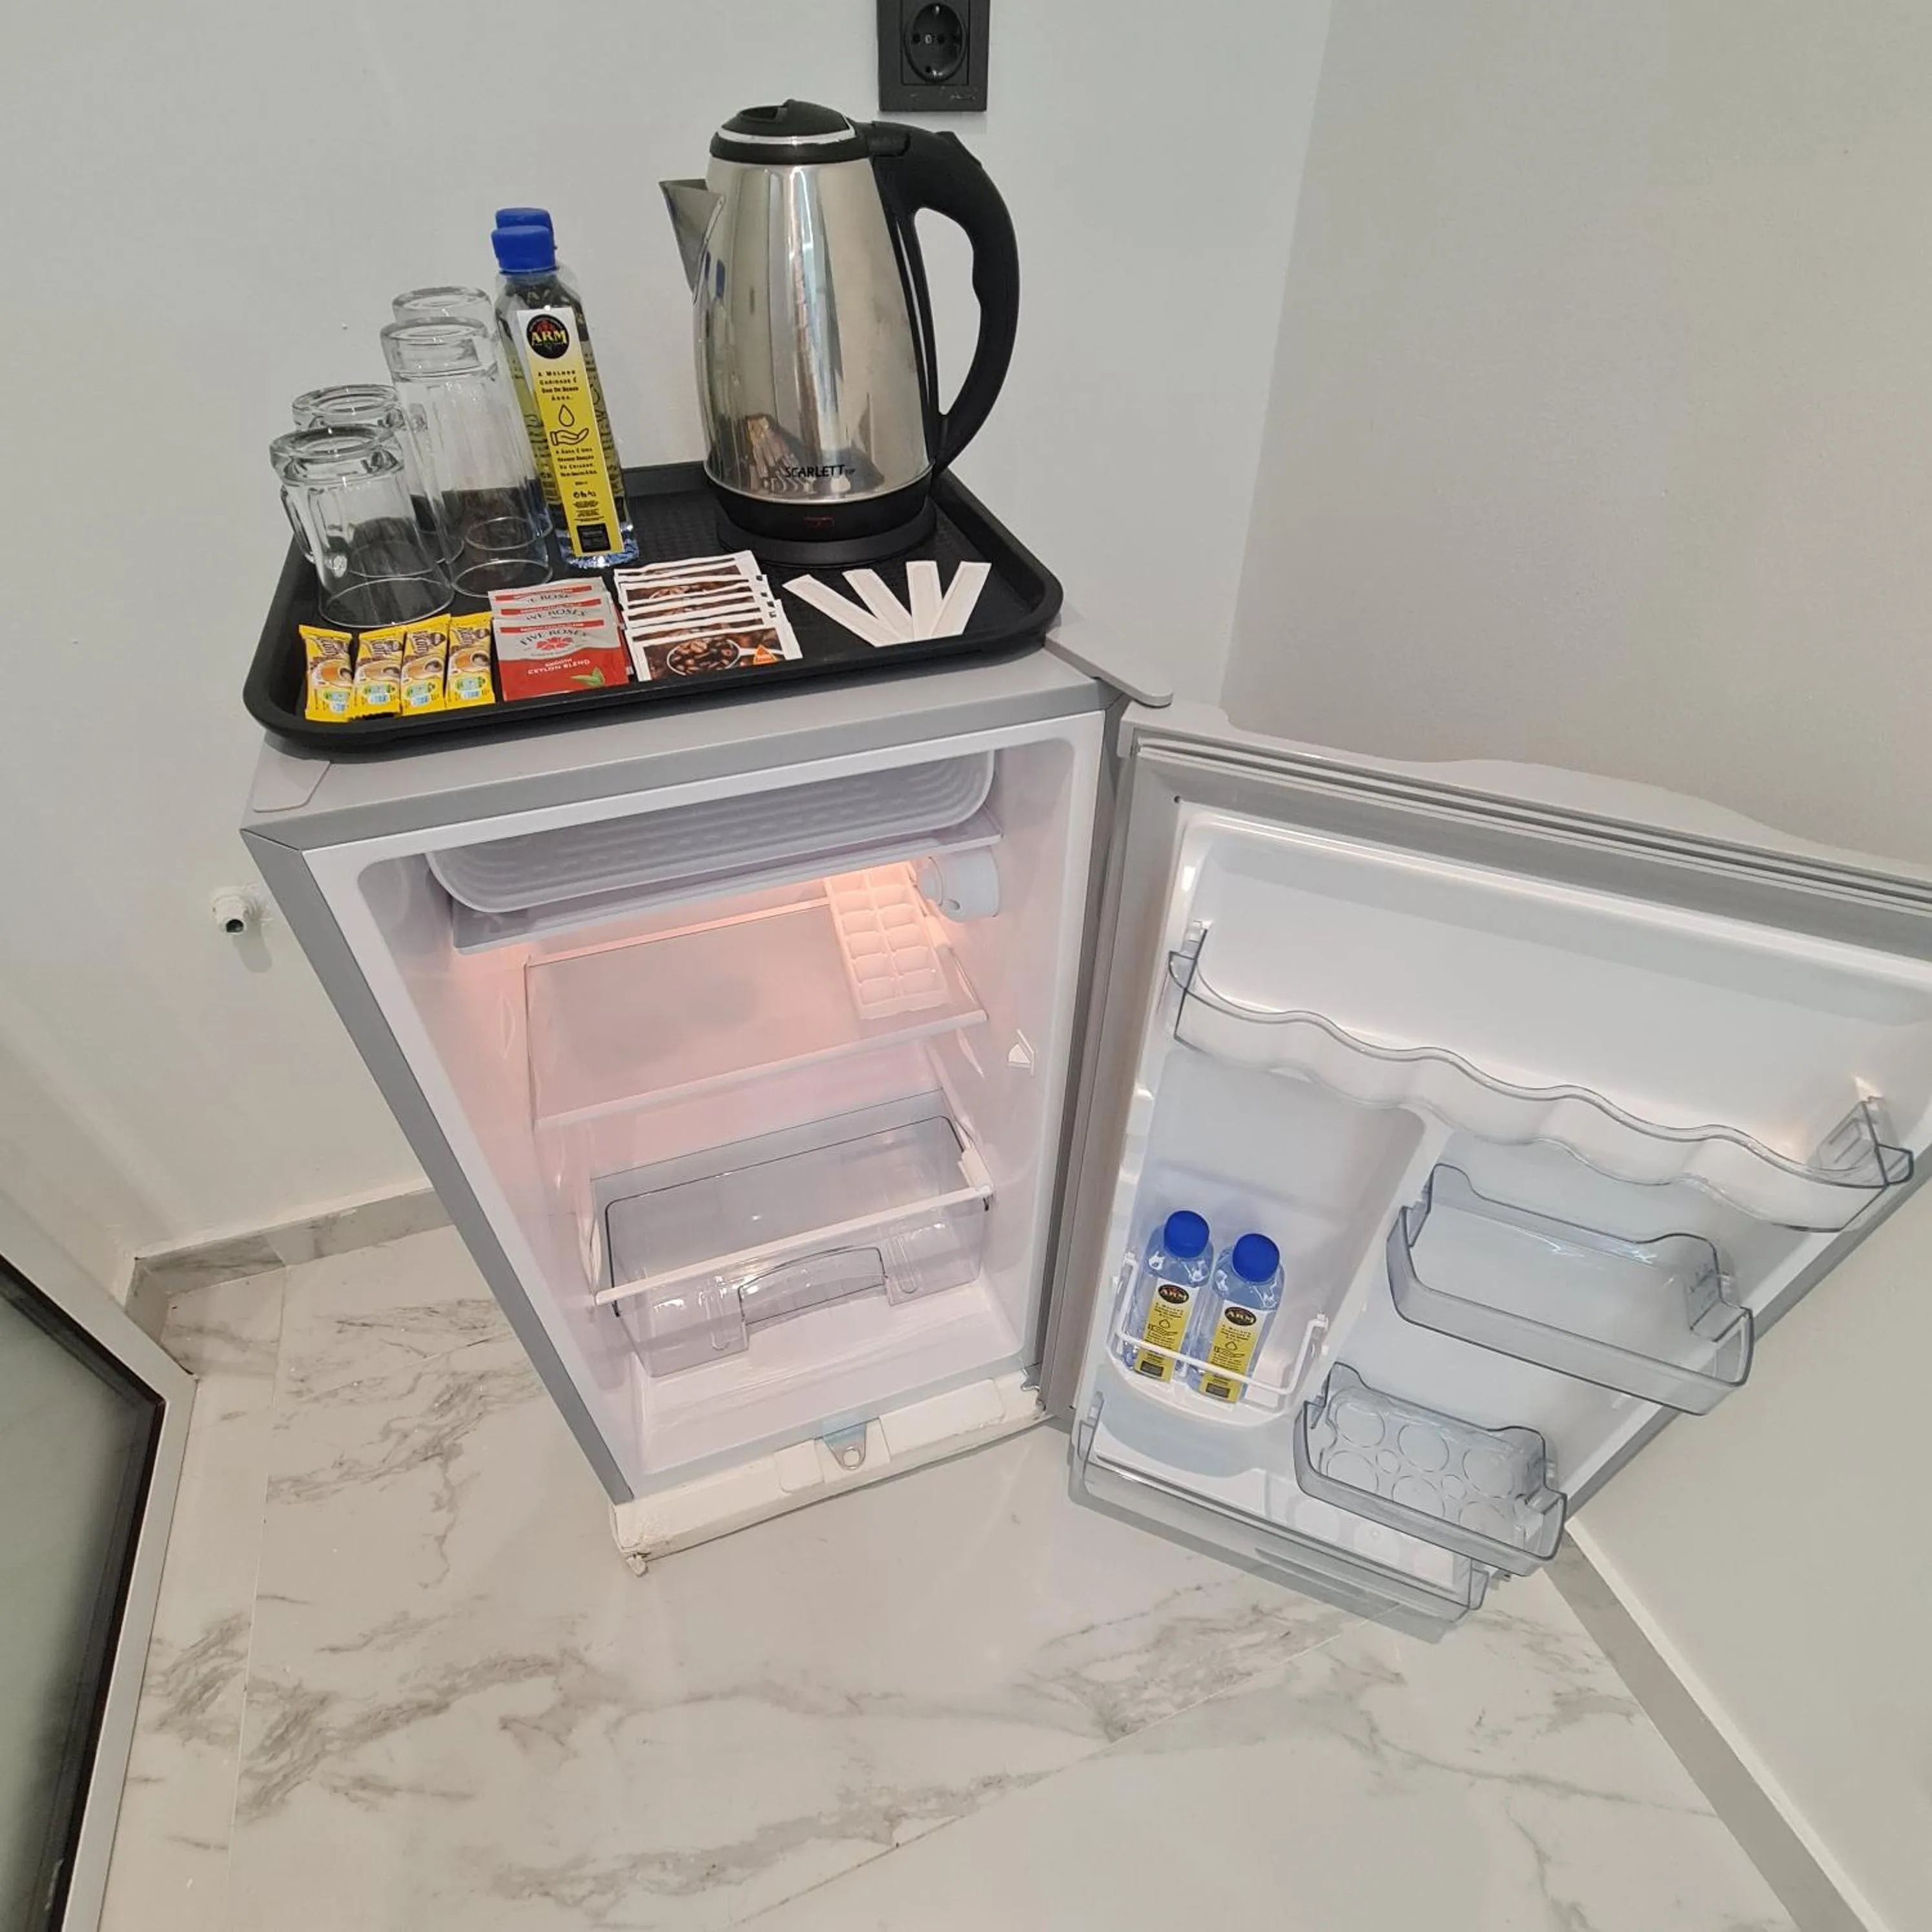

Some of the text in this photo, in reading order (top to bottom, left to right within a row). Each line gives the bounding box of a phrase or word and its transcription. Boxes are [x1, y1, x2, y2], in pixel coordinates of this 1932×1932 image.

[531, 329, 568, 346] ARM
[785, 464, 845, 478] SCARLETT
[520, 632, 542, 646] FIVE
[528, 659, 590, 675] CEYLON BLEND
[1227, 1310, 1254, 1323] ARM
